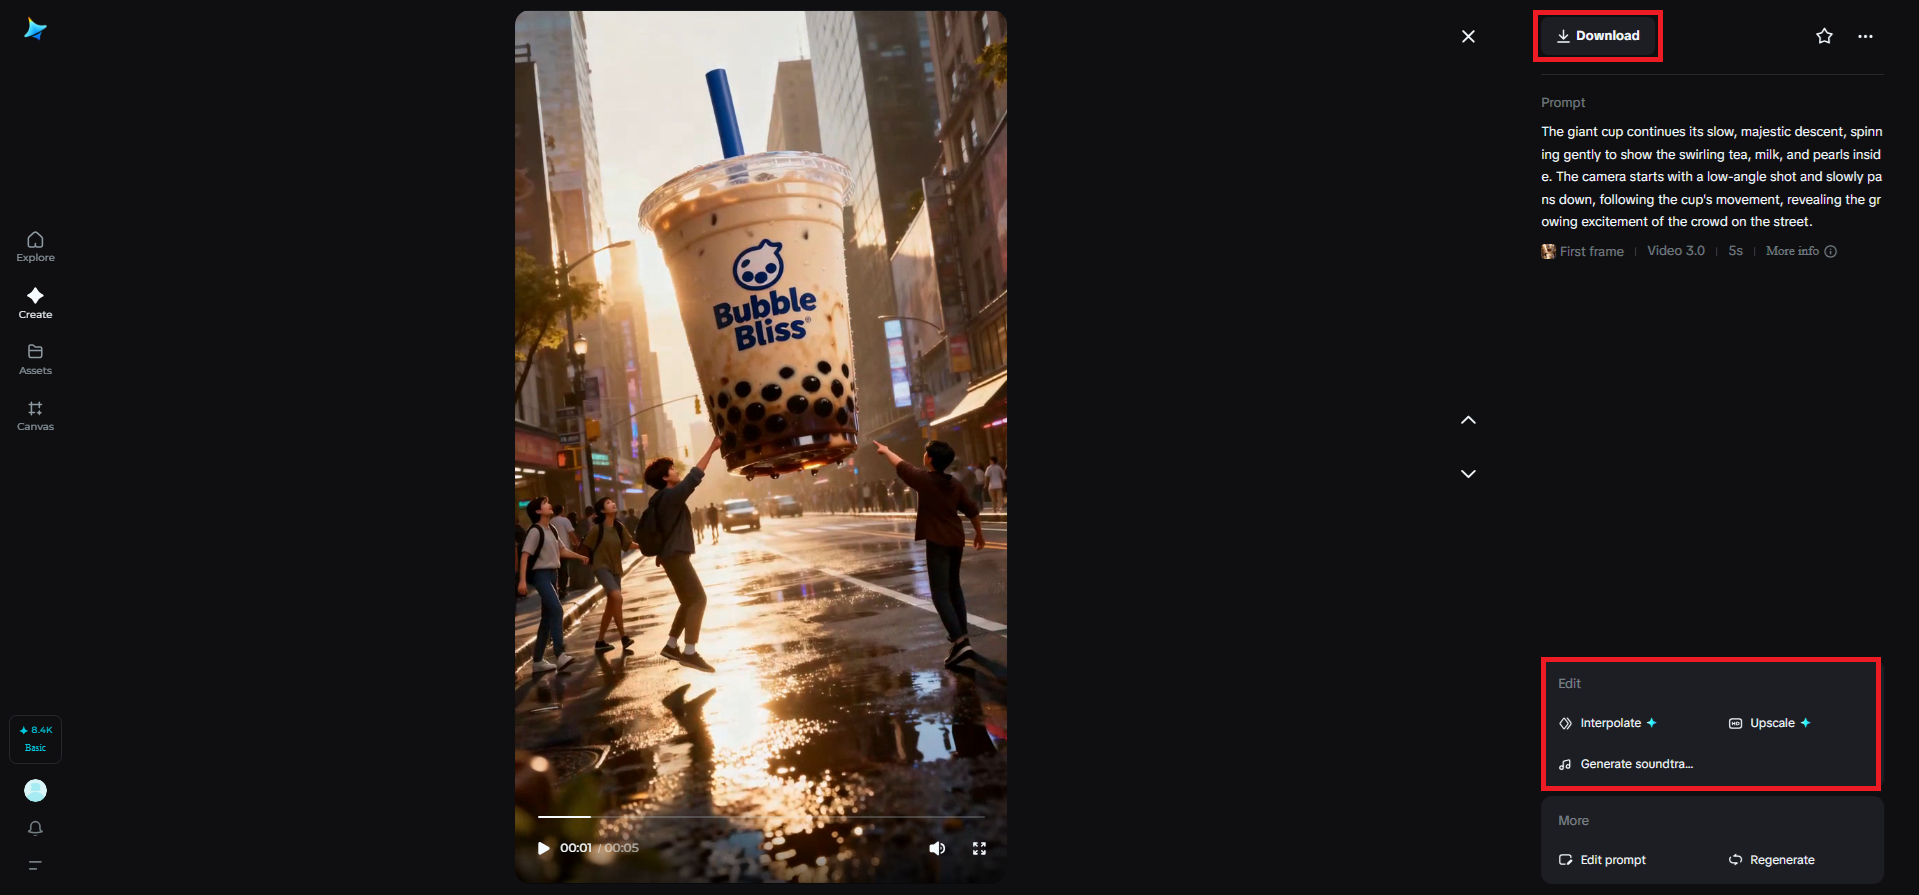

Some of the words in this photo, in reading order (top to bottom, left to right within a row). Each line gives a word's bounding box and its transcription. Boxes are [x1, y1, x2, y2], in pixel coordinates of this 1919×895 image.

[1575, 29, 1641, 42] Download
[1541, 97, 1587, 111] Prompt
[1540, 125, 1565, 138] The
[1566, 125, 1599, 140] giant
[1600, 128, 1624, 140] cup
[1626, 125, 1687, 138] continues
[1688, 125, 1705, 138] its
[1706, 125, 1738, 140] slow,
[1740, 125, 1792, 140] majestic
[1793, 125, 1848, 140] descent,
[1849, 125, 1883, 140] spinn
[1540, 148, 1560, 163] ing
[1562, 148, 1602, 163] gently
[1603, 149, 1618, 161] to
[1619, 148, 1653, 161] show
[1655, 148, 1677, 161] the
[1678, 148, 1725, 163] swirling
[1727, 149, 1752, 163] tea,
[1754, 148, 1784, 163] milk,
[1785, 148, 1810, 161] and
[1812, 148, 1850, 163] pearls
[1852, 148, 1882, 161] insid
[1540, 173, 1553, 183] e.
[1555, 170, 1580, 183] The
[1581, 173, 1627, 183] camera
[1628, 171, 1665, 183] starts
[1666, 170, 1694, 183] with
[1695, 173, 1705, 183] a
[1706, 170, 1768, 185] low-angle
[1769, 170, 1798, 183] shot
[1799, 170, 1823, 183] and
[1825, 170, 1865, 185] slowly
[1866, 173, 1883, 185] pa
[1541, 196, 1556, 206] ns
[1558, 193, 1597, 208] down,
[1598, 193, 1655, 208] following
[1657, 193, 1679, 206] the
[1680, 193, 1713, 208] cup's
[1715, 194, 1784, 208] movement,
[1786, 193, 1842, 208] revealing
[1844, 193, 1866, 206] the
[1867, 196, 1882, 208] gr
[1540, 215, 1578, 230] owing
[1580, 215, 1649, 228] excitement
[1650, 215, 1665, 228] of
[1666, 215, 1688, 228] the
[1690, 215, 1729, 228] crowd
[1730, 218, 1747, 228] on
[1749, 215, 1771, 228] the
[1772, 216, 1813, 228] street.
[1559, 245, 1587, 257] First
[1588, 245, 1625, 257] frame
[1646, 244, 1683, 256] Video
[1685, 244, 1706, 256] 3.0
[1728, 245, 1744, 256] 5s
[1765, 245, 1796, 256] More
[1797, 245, 1820, 256] info
[16, 252, 56, 264] Explore
[713, 286, 817, 330] Bubble
[18, 310, 54, 319] Create
[18, 366, 53, 375] Assets
[16, 422, 55, 431] Canvas
[1558, 677, 1582, 689] Edit
[30, 725, 54, 734] 8.4K
[1580, 717, 1642, 731] Interpolate
[1750, 717, 1796, 731] Upscale
[24, 743, 47, 752] Basic
[1580, 758, 1633, 770] Generate
[1558, 815, 1590, 826] More
[559, 842, 593, 854] 00:01
[1580, 854, 1603, 866] Edit
[1604, 854, 1647, 868] prompt
[1750, 854, 1816, 868] Regenerate
